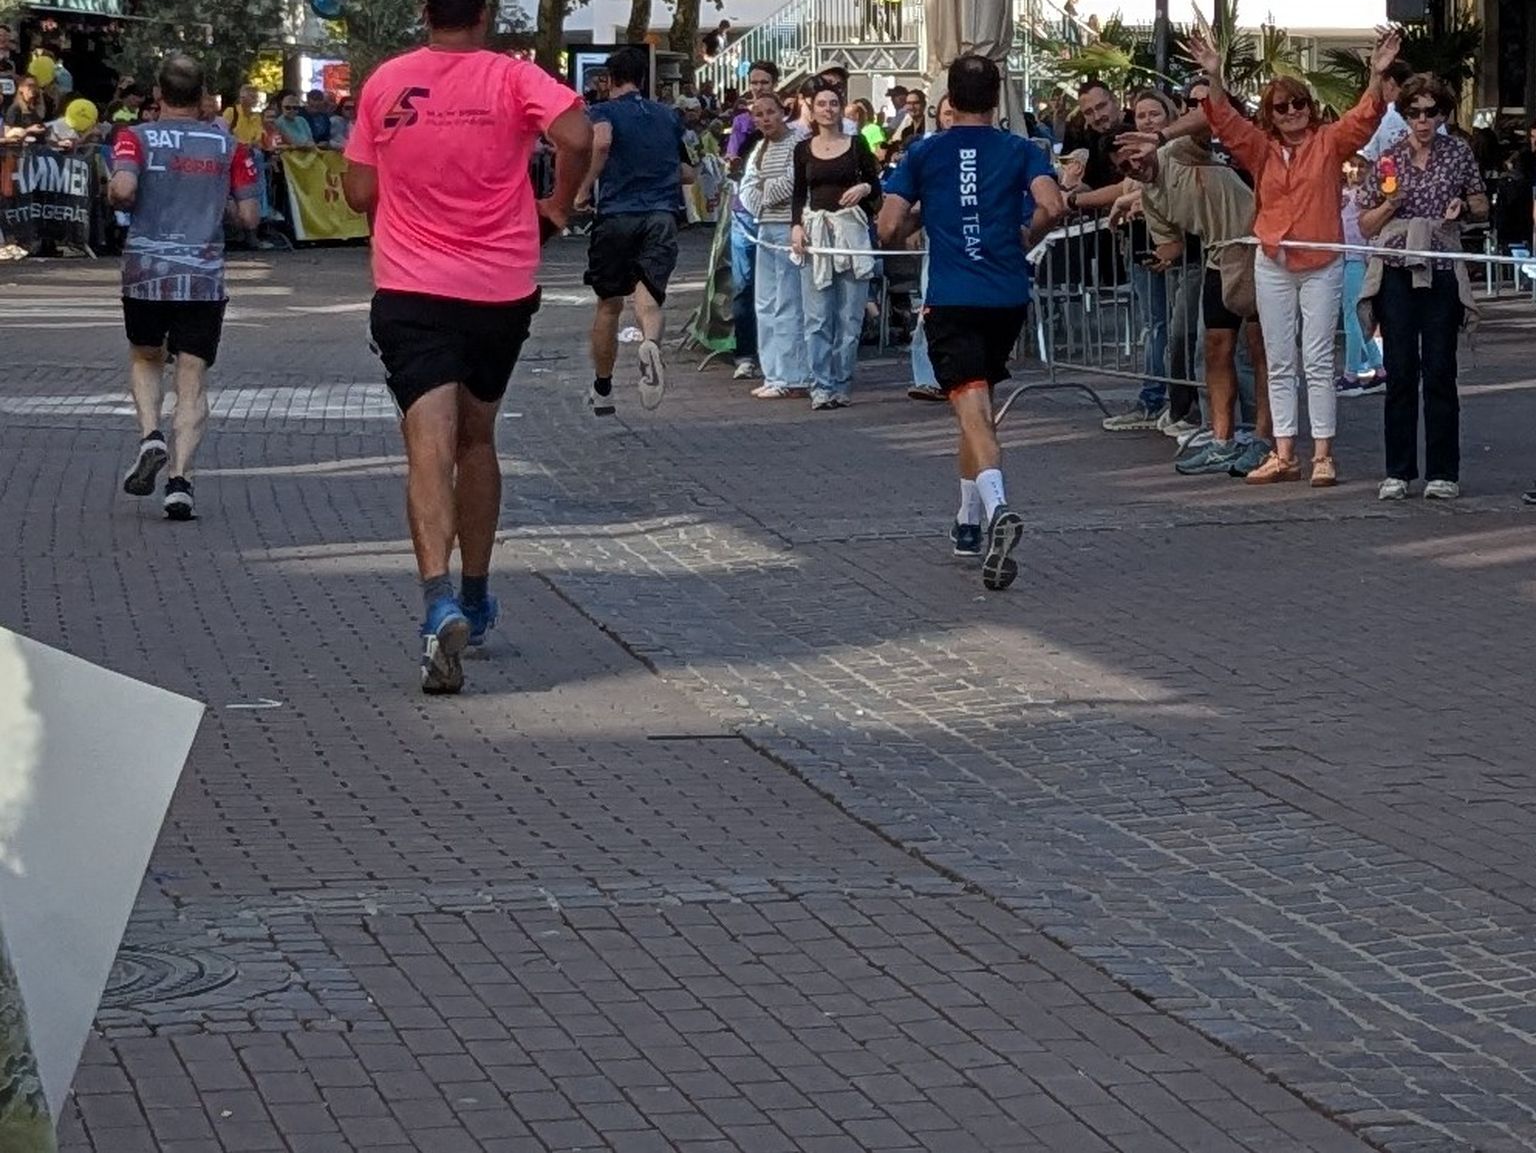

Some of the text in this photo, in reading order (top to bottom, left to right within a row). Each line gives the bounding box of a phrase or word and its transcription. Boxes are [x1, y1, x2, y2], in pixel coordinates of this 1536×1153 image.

[145, 130, 184, 149] BAT
[959, 148, 984, 261] BUSSE TEAM
